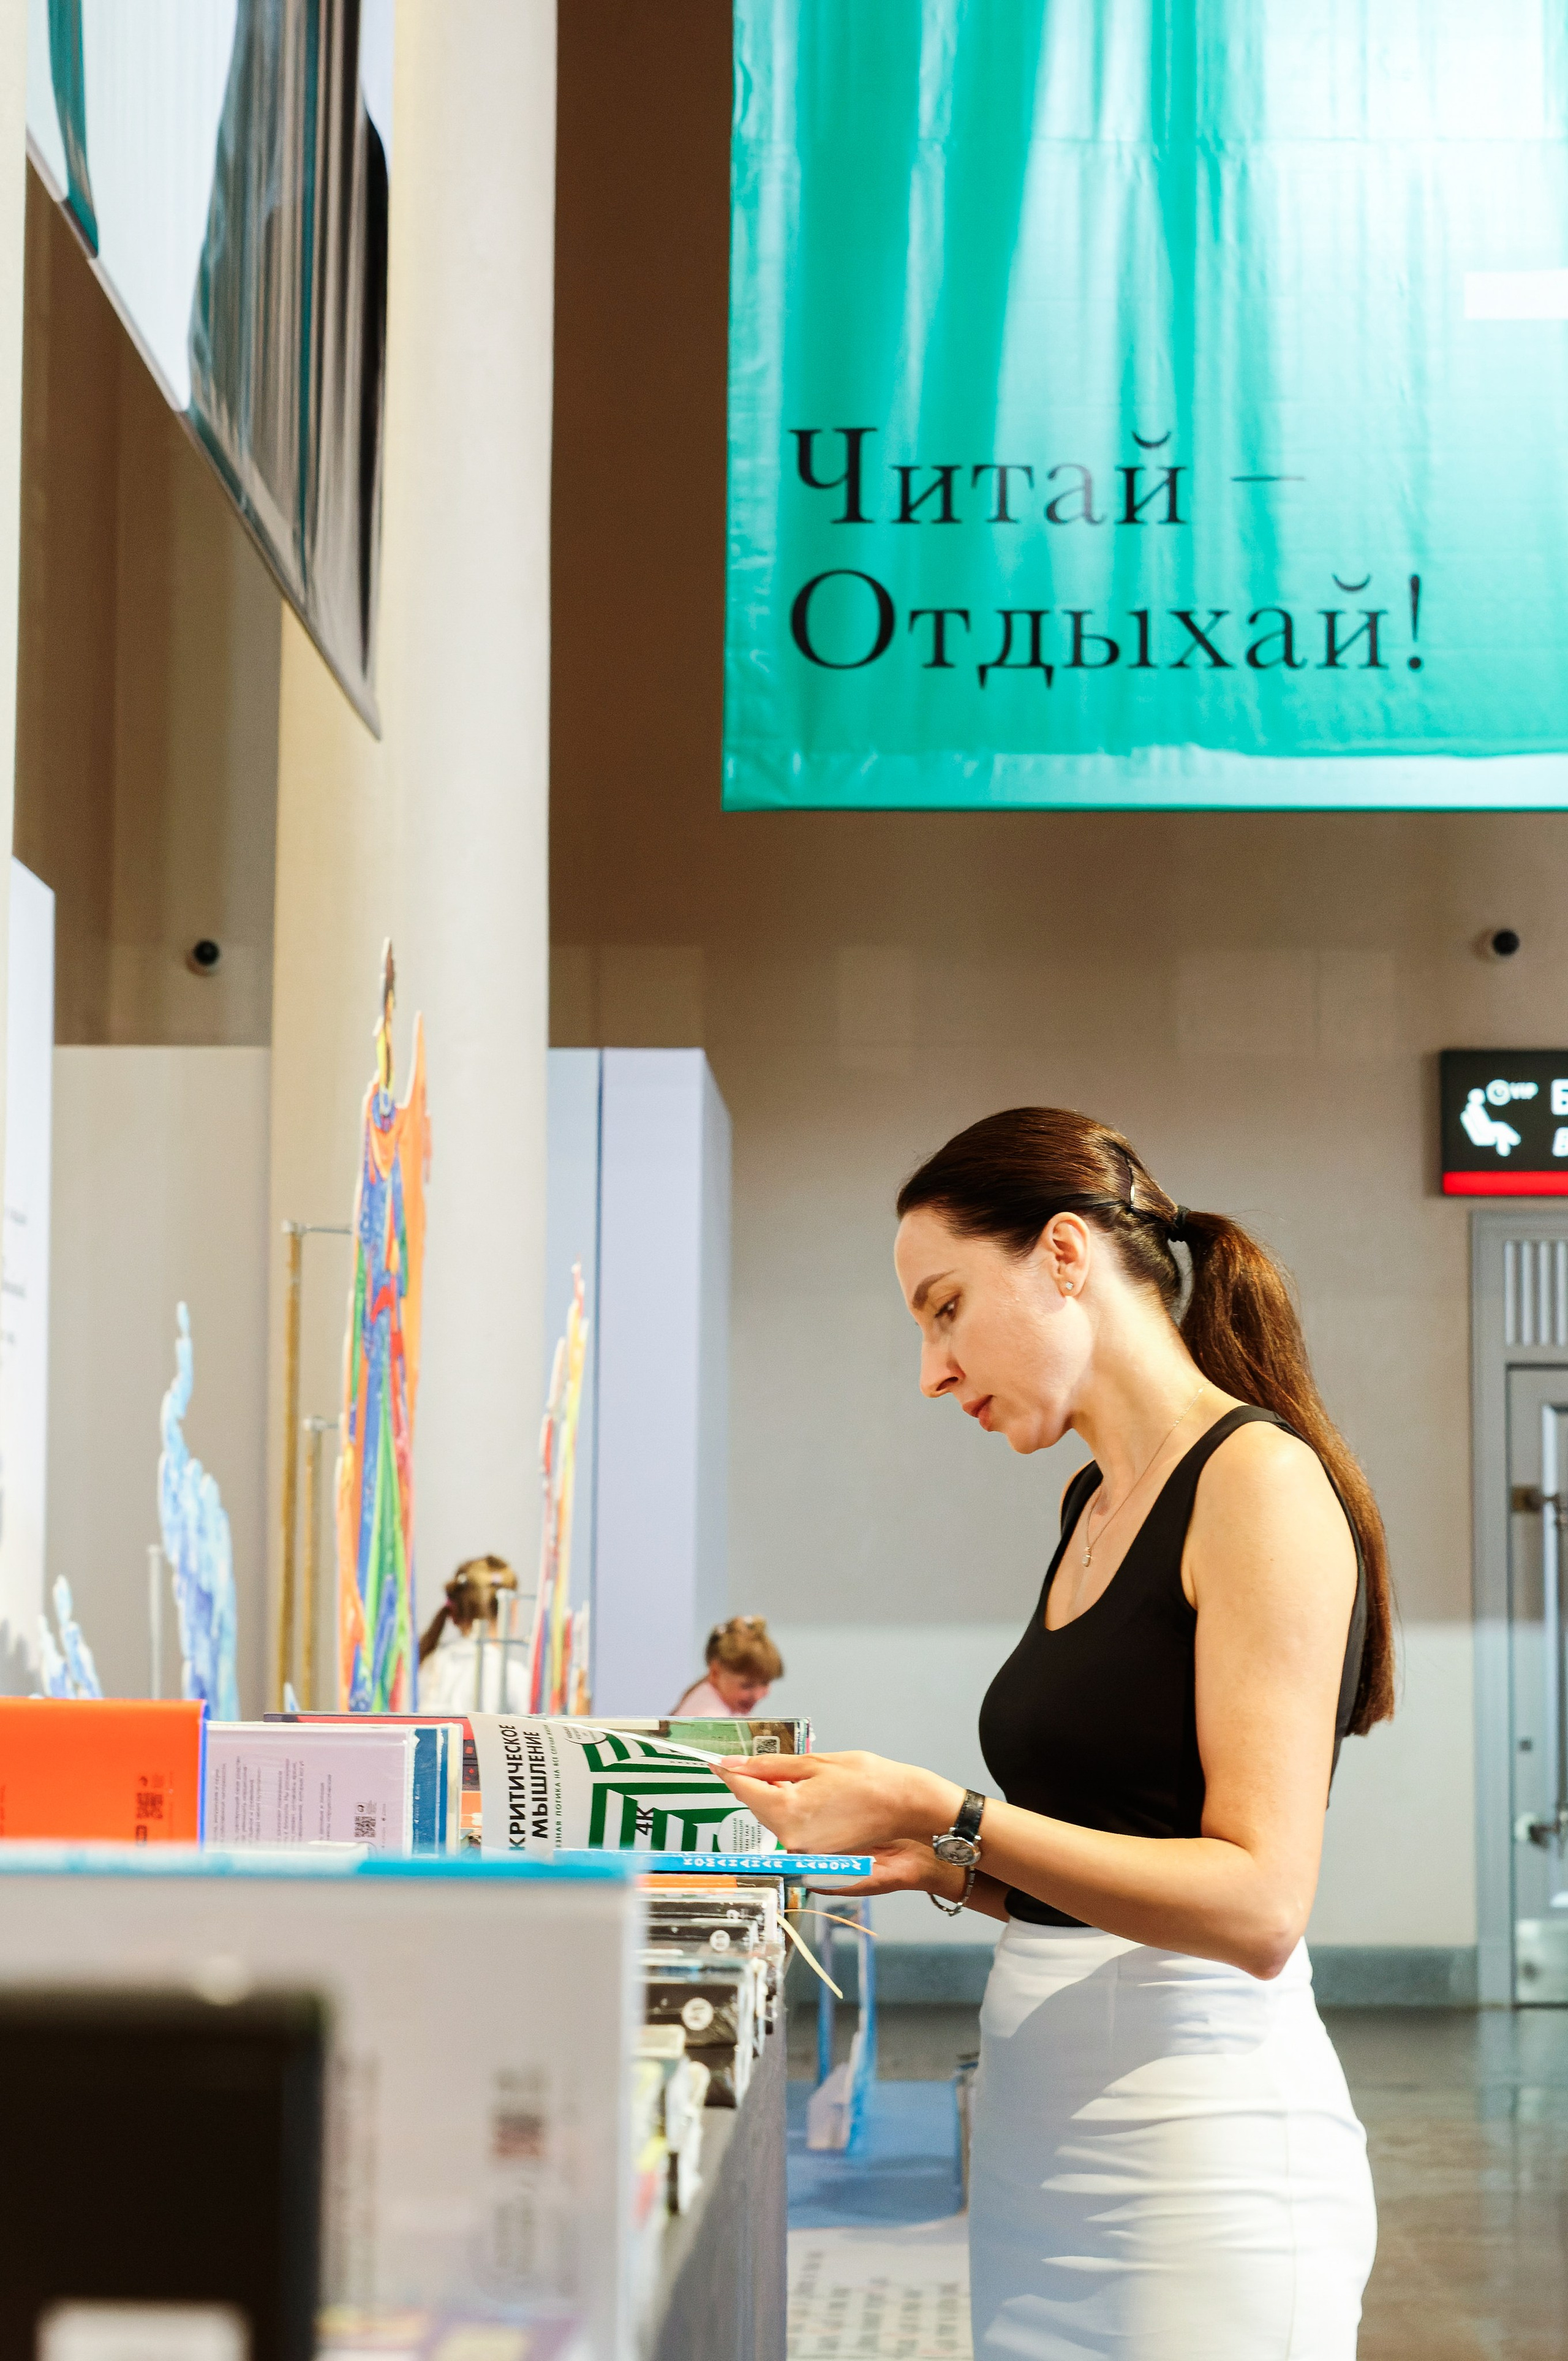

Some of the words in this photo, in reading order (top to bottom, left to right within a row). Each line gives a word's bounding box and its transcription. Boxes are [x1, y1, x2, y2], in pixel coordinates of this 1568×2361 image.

[789, 427, 1188, 524] Читай
[790, 569, 1423, 690] Отдыхай!
[499, 1724, 526, 1851] КРИТИЧЕСКОЕ
[523, 1731, 548, 1839] МЫШЛЕНИЕ
[554, 1769, 561, 1779] НА
